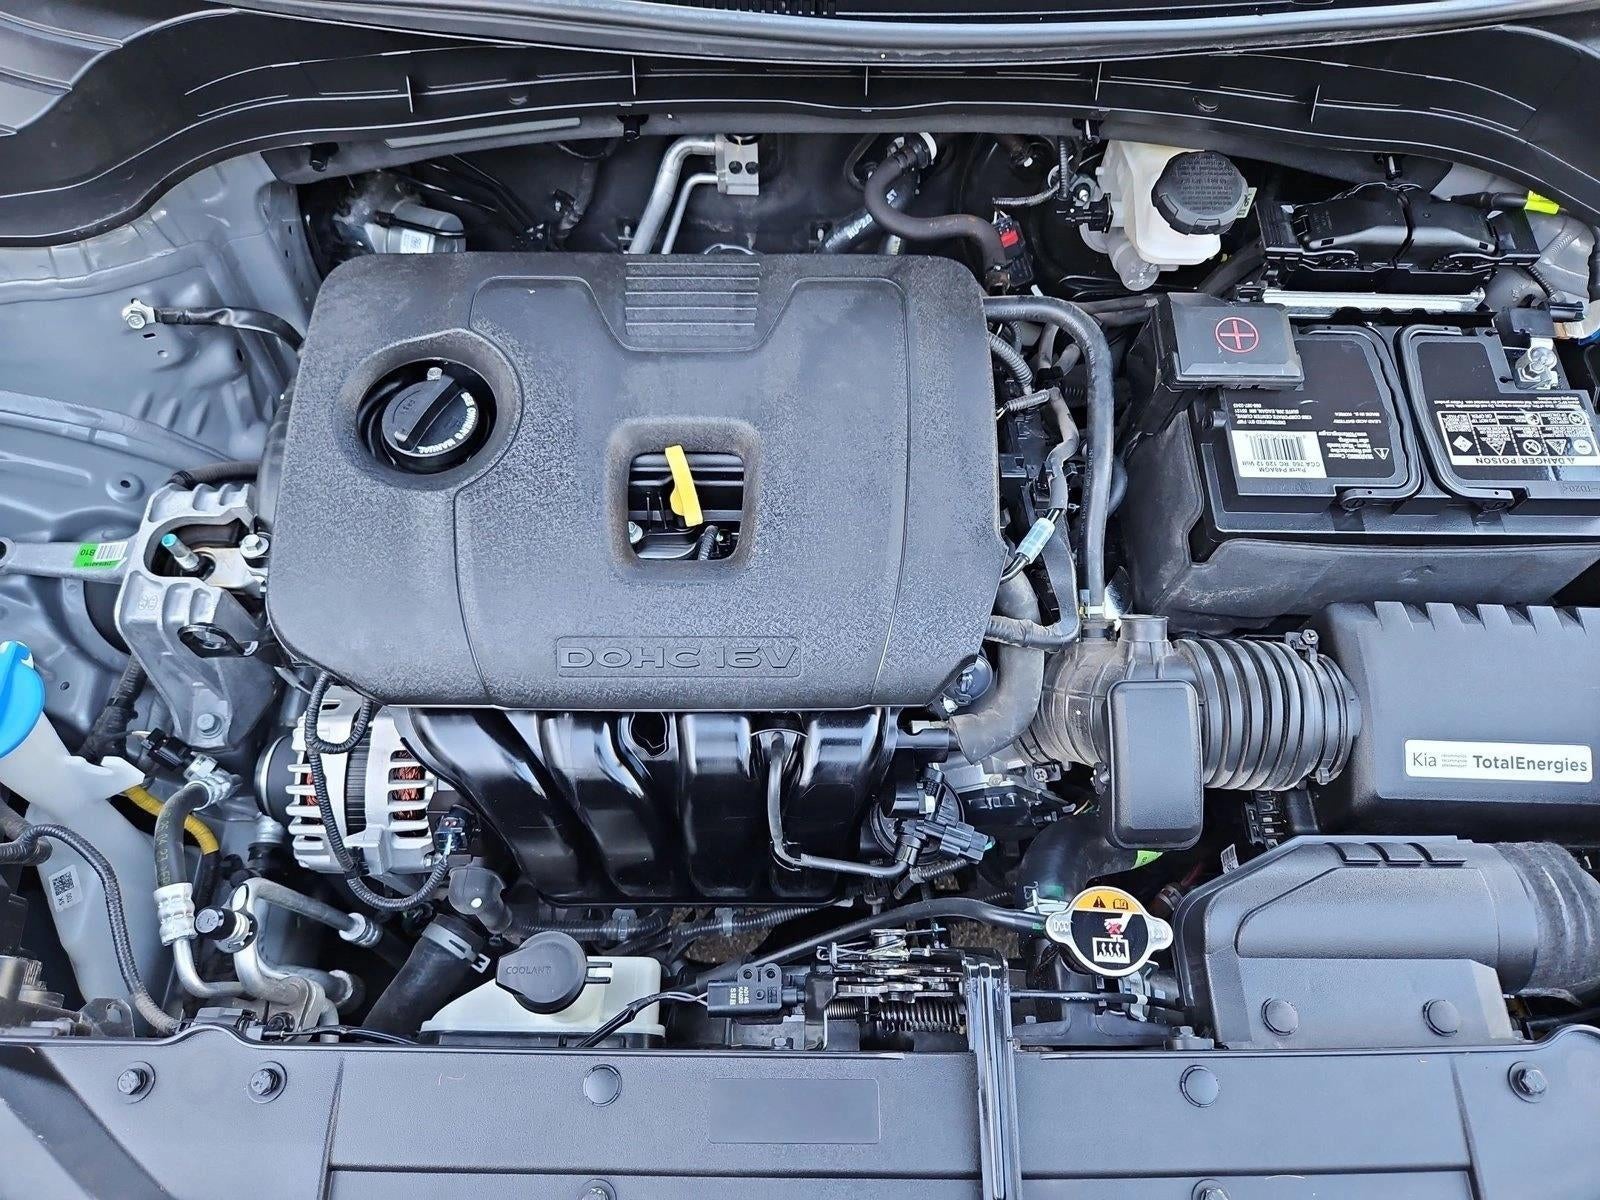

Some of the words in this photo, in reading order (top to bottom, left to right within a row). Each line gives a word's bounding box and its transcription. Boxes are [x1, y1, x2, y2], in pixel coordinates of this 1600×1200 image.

[461, 392, 475, 407] SEE
[417, 438, 456, 453] MANUAL
[560, 646, 701, 669] DOHC
[715, 645, 798, 669] 16V
[1412, 752, 1437, 767] Kia
[1473, 754, 1588, 774] TotalEnergies
[505, 965, 553, 976] COOLANT
